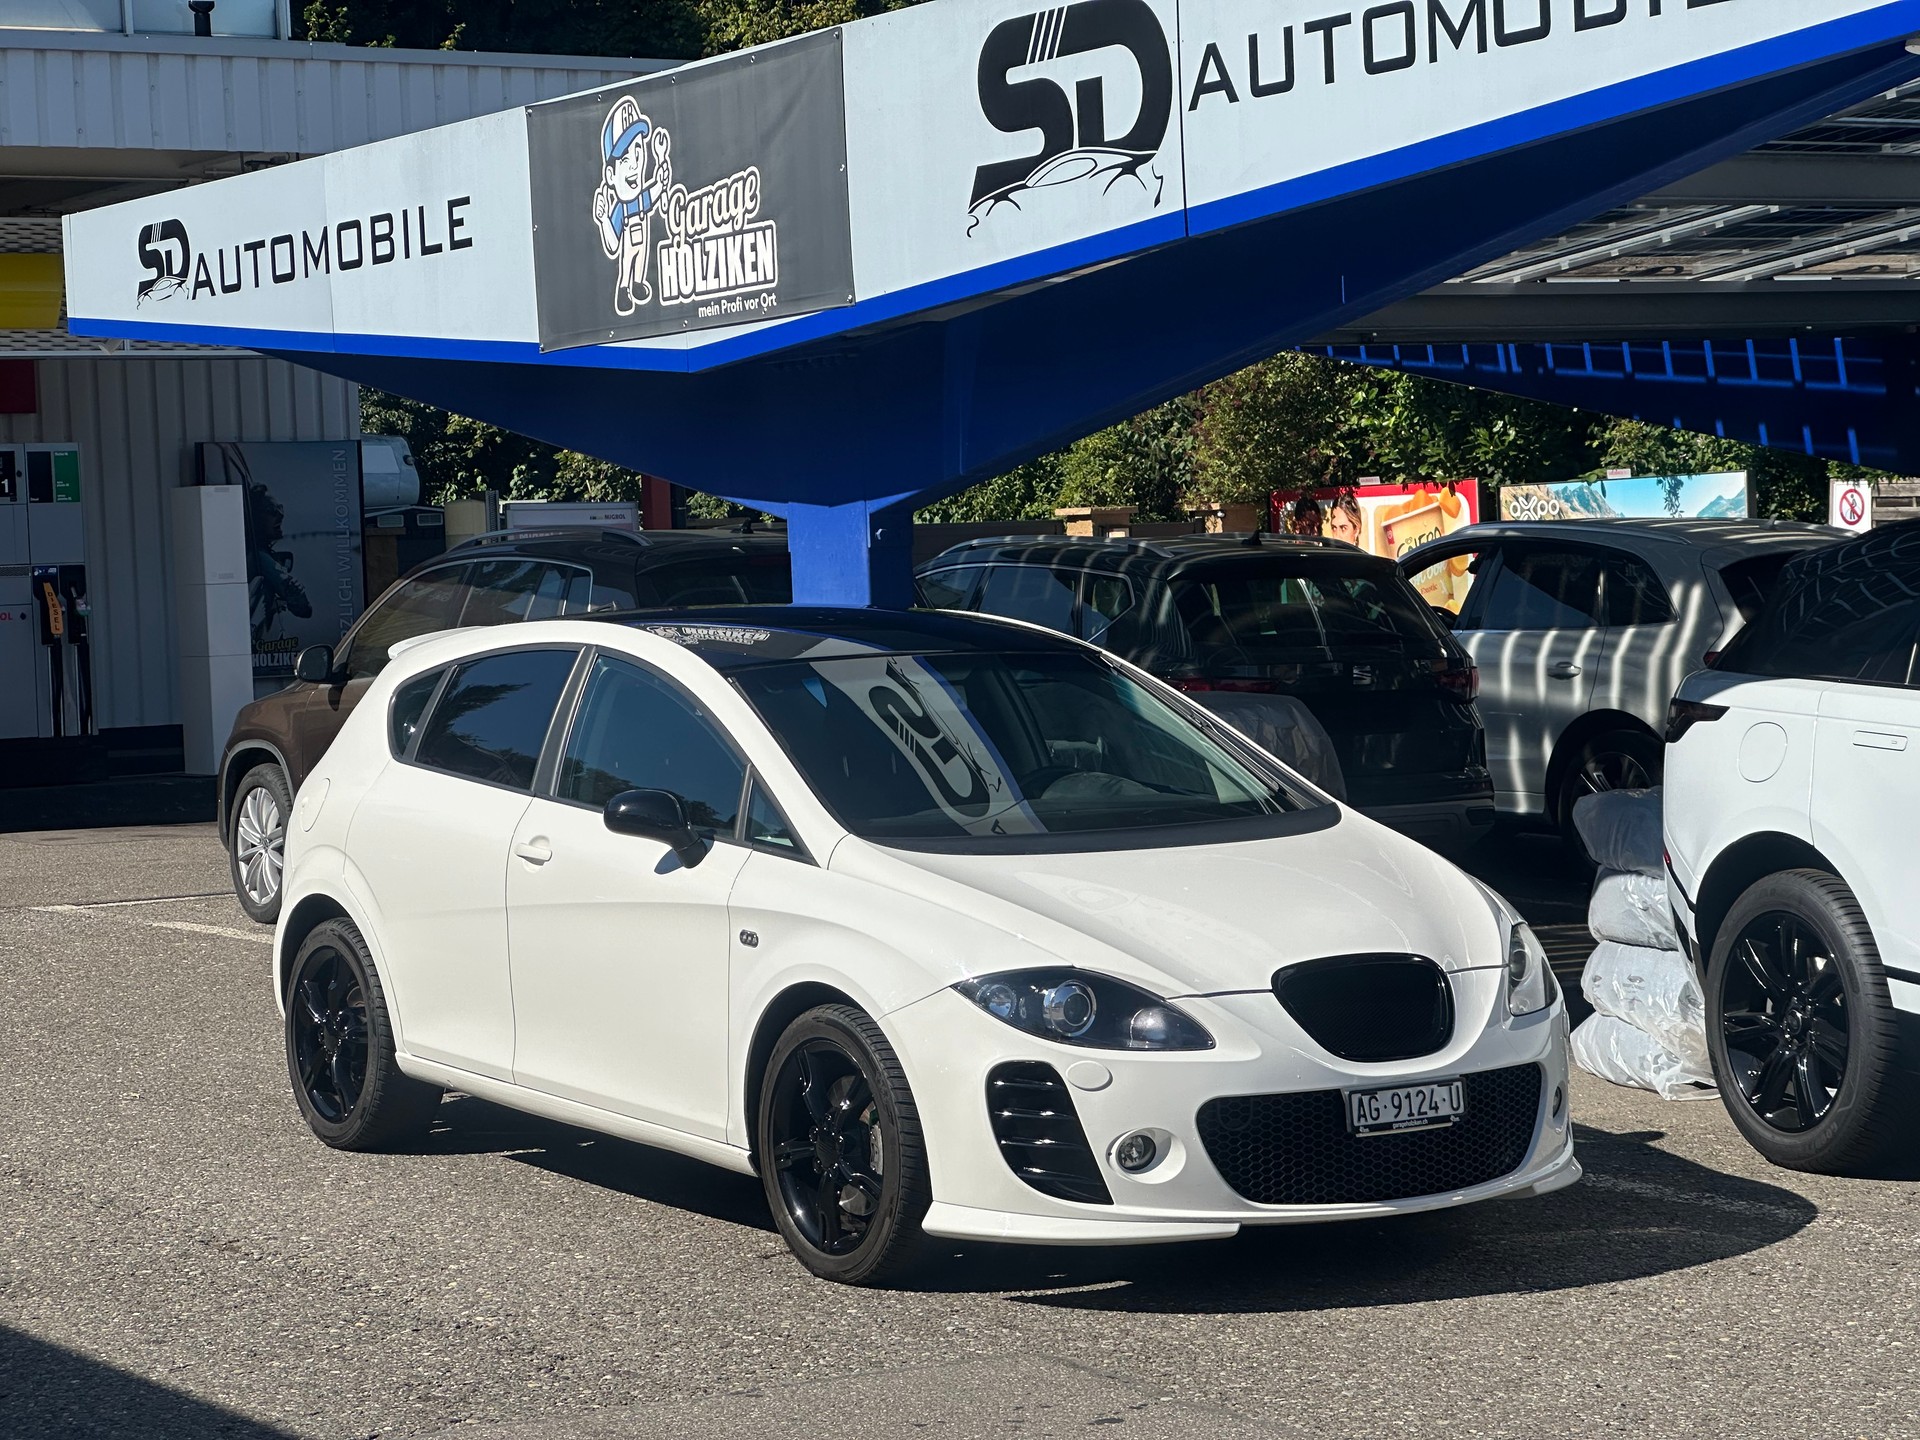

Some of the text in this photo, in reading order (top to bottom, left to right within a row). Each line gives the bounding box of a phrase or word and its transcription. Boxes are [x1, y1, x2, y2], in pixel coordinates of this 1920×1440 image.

[621, 103, 634, 131] GB
[968, 0, 1172, 211] SD
[668, 170, 758, 246] Garage
[137, 218, 190, 300] SD
[192, 196, 473, 300] AUTOMOBILE
[660, 228, 774, 297] HOLZIKEN
[698, 292, 777, 318] mein Profi vor Ort
[332, 449, 352, 572] WILLKOMMEN
[46, 591, 61, 632] DIESEL
[255, 637, 298, 653] Garage
